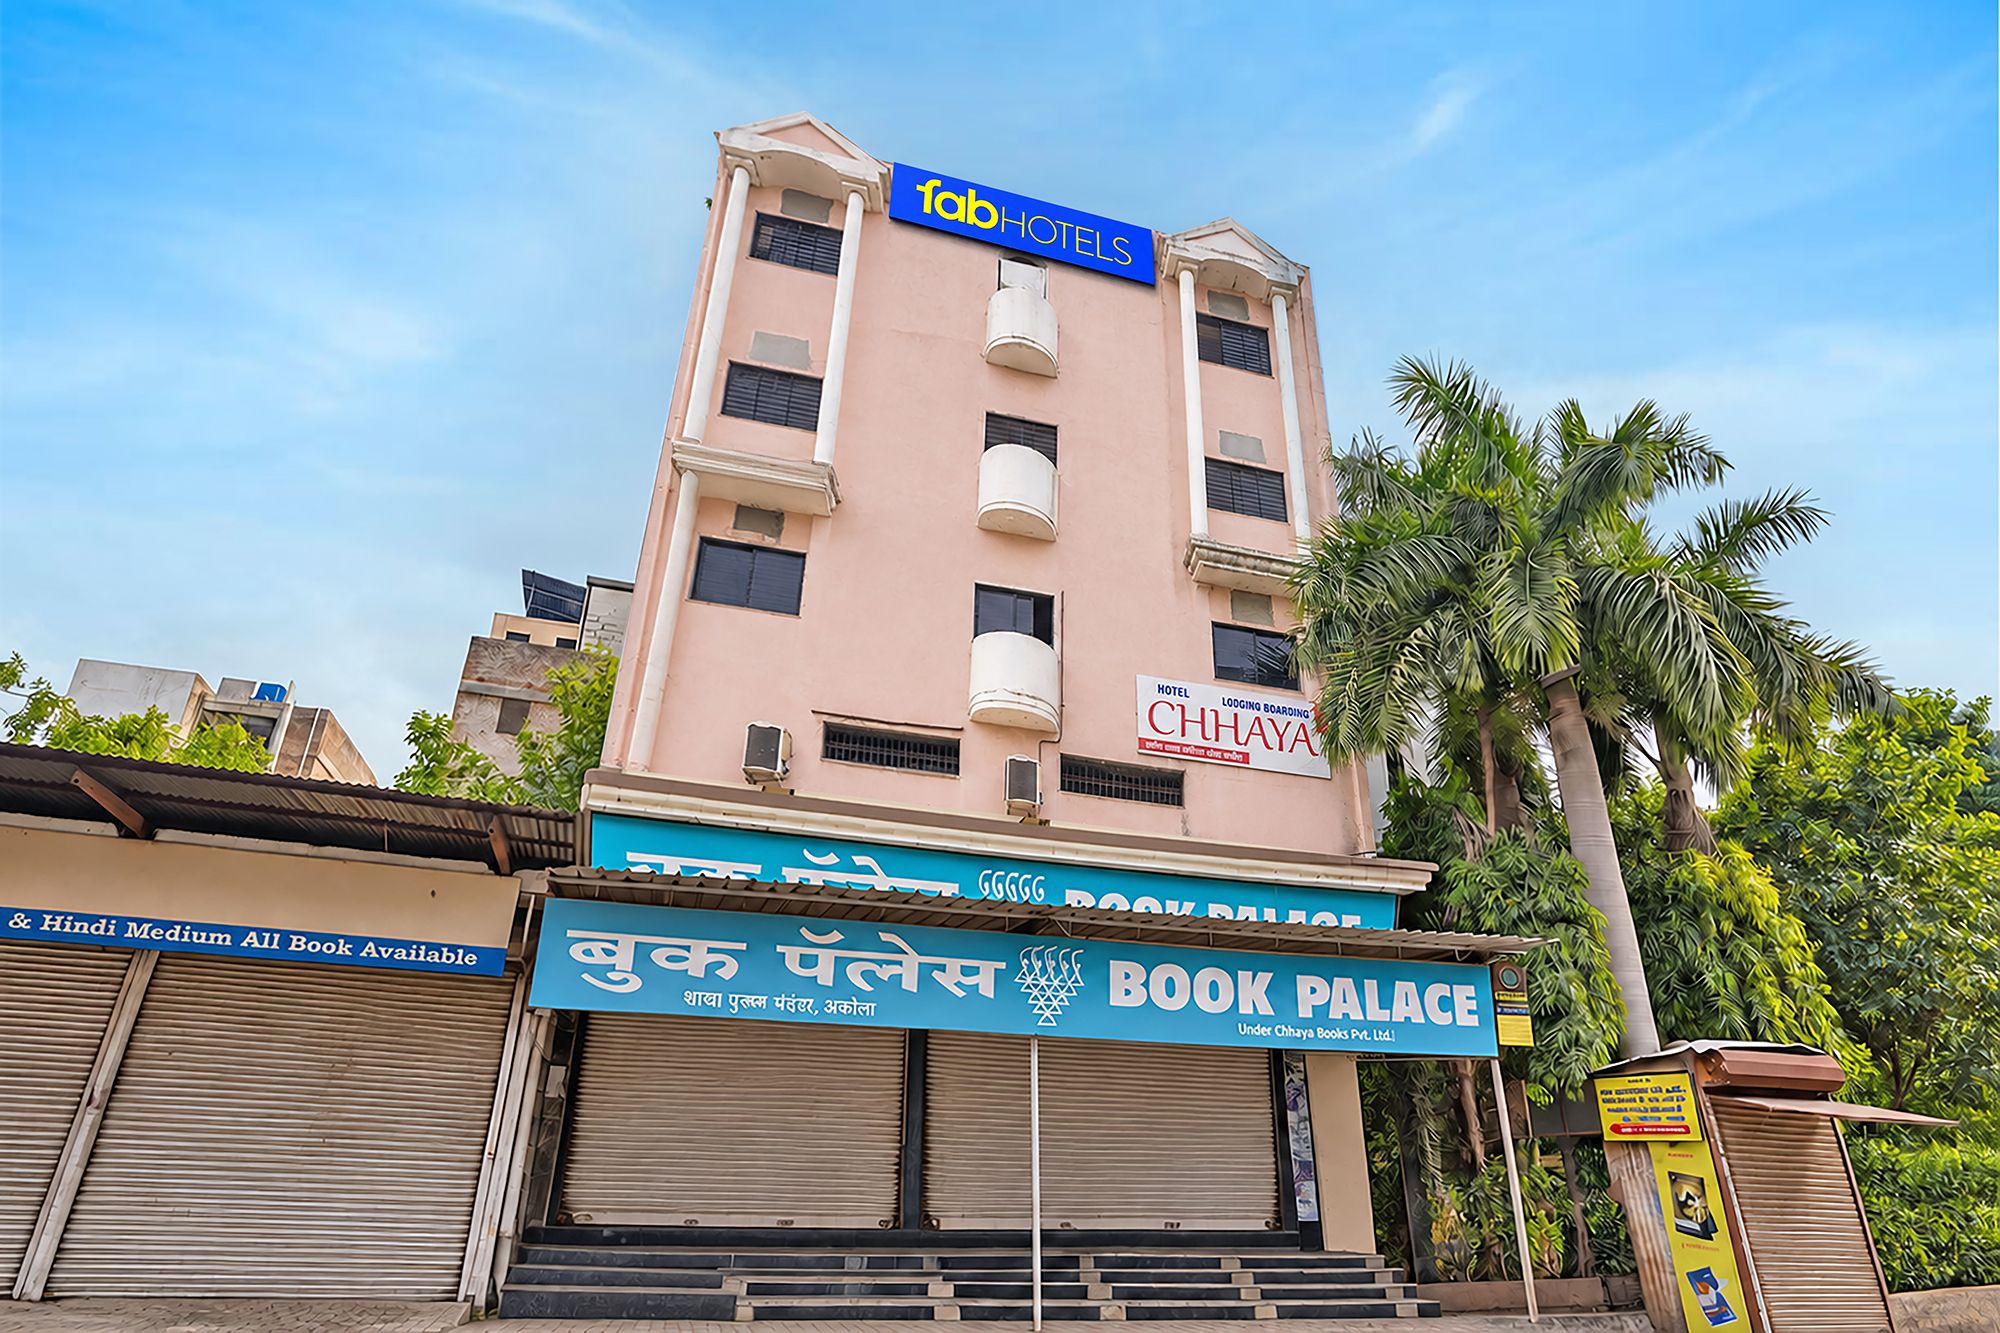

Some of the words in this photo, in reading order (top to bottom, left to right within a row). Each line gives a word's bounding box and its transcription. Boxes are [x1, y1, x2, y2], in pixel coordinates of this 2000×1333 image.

[1157, 683, 1190, 698] HOTEL
[1222, 697, 1261, 711] LODGING
[1263, 703, 1310, 719] BOARDING
[1148, 700, 1319, 757] CHHAYA
[8, 912, 31, 930] &
[40, 914, 117, 936] Hindi
[124, 921, 232, 946] Medium
[240, 931, 281, 950] All
[288, 935, 352, 957] Book
[360, 941, 478, 966] Available
[566, 929, 747, 994] बुक
[775, 926, 1007, 999] पॅलेस
[824, 996, 877, 1017] अकोला
[1109, 959, 1275, 1016] BOOK
[1296, 974, 1480, 1027] PALACE
[1237, 1022, 1272, 1037] Under
[1274, 1025, 1315, 1041] Chhaya
[1316, 1027, 1350, 1041] Books
